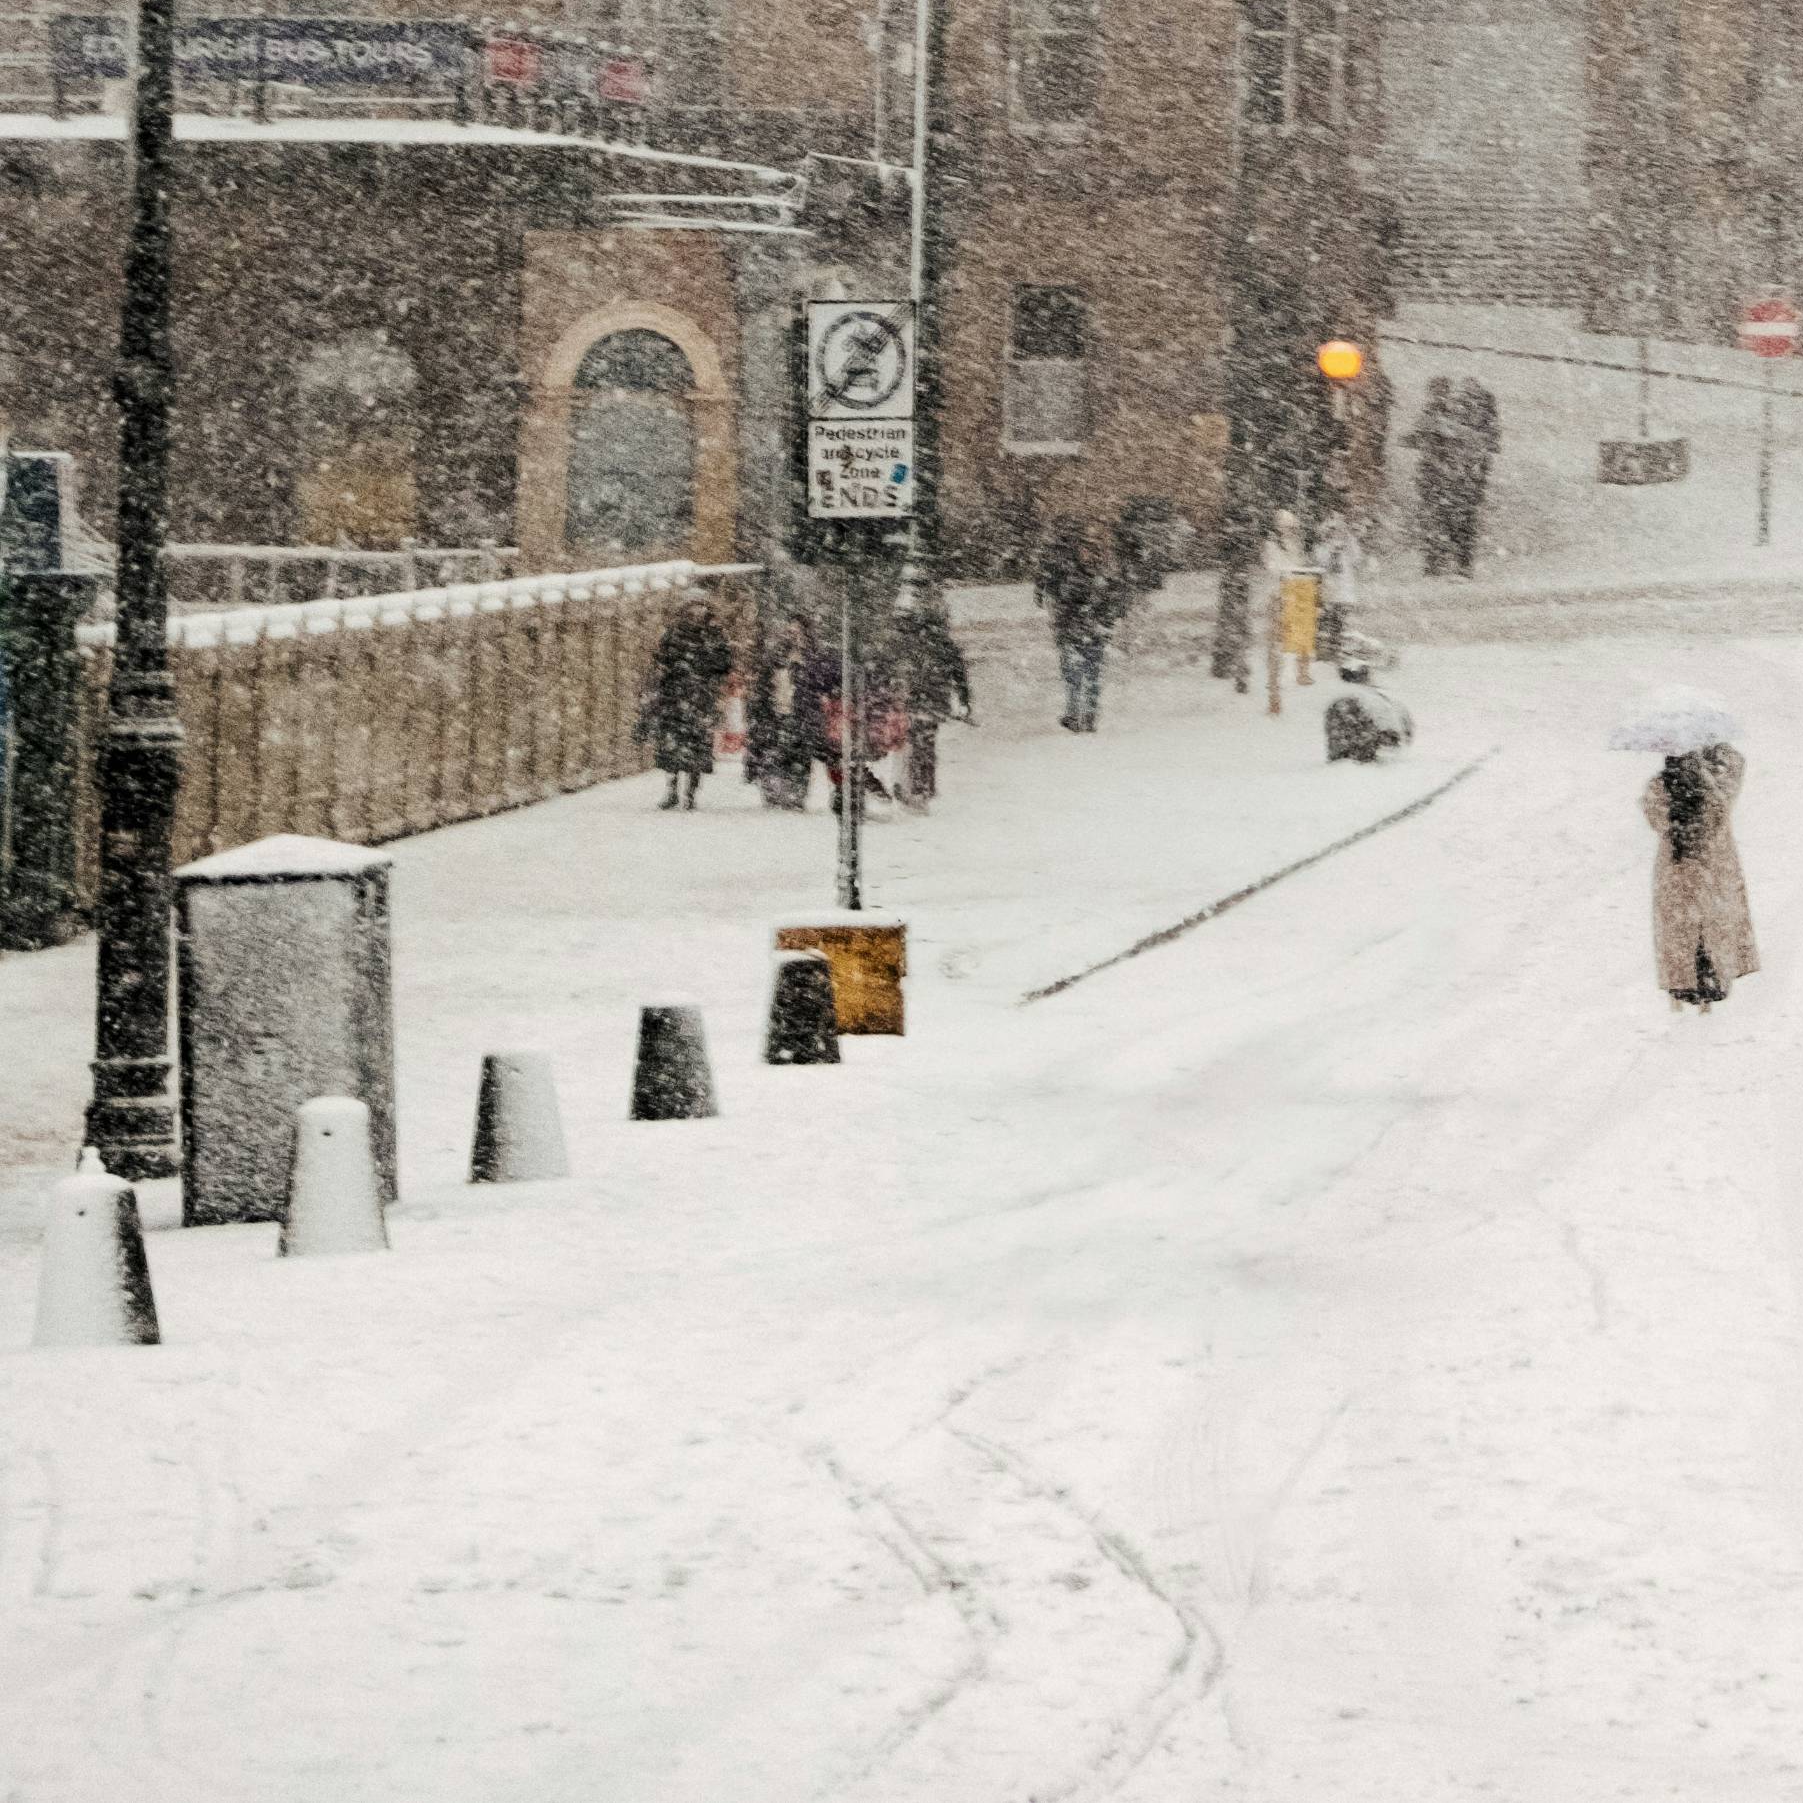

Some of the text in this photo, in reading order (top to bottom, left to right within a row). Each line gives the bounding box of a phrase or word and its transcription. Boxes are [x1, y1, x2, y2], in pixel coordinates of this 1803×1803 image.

[265, 38, 332, 64] BUS
[334, 39, 433, 69] TOURS
[815, 426, 905, 441] Pedestrian
[856, 447, 900, 461] cycle
[840, 464, 880, 479] Zone
[821, 485, 898, 508] ENDS
